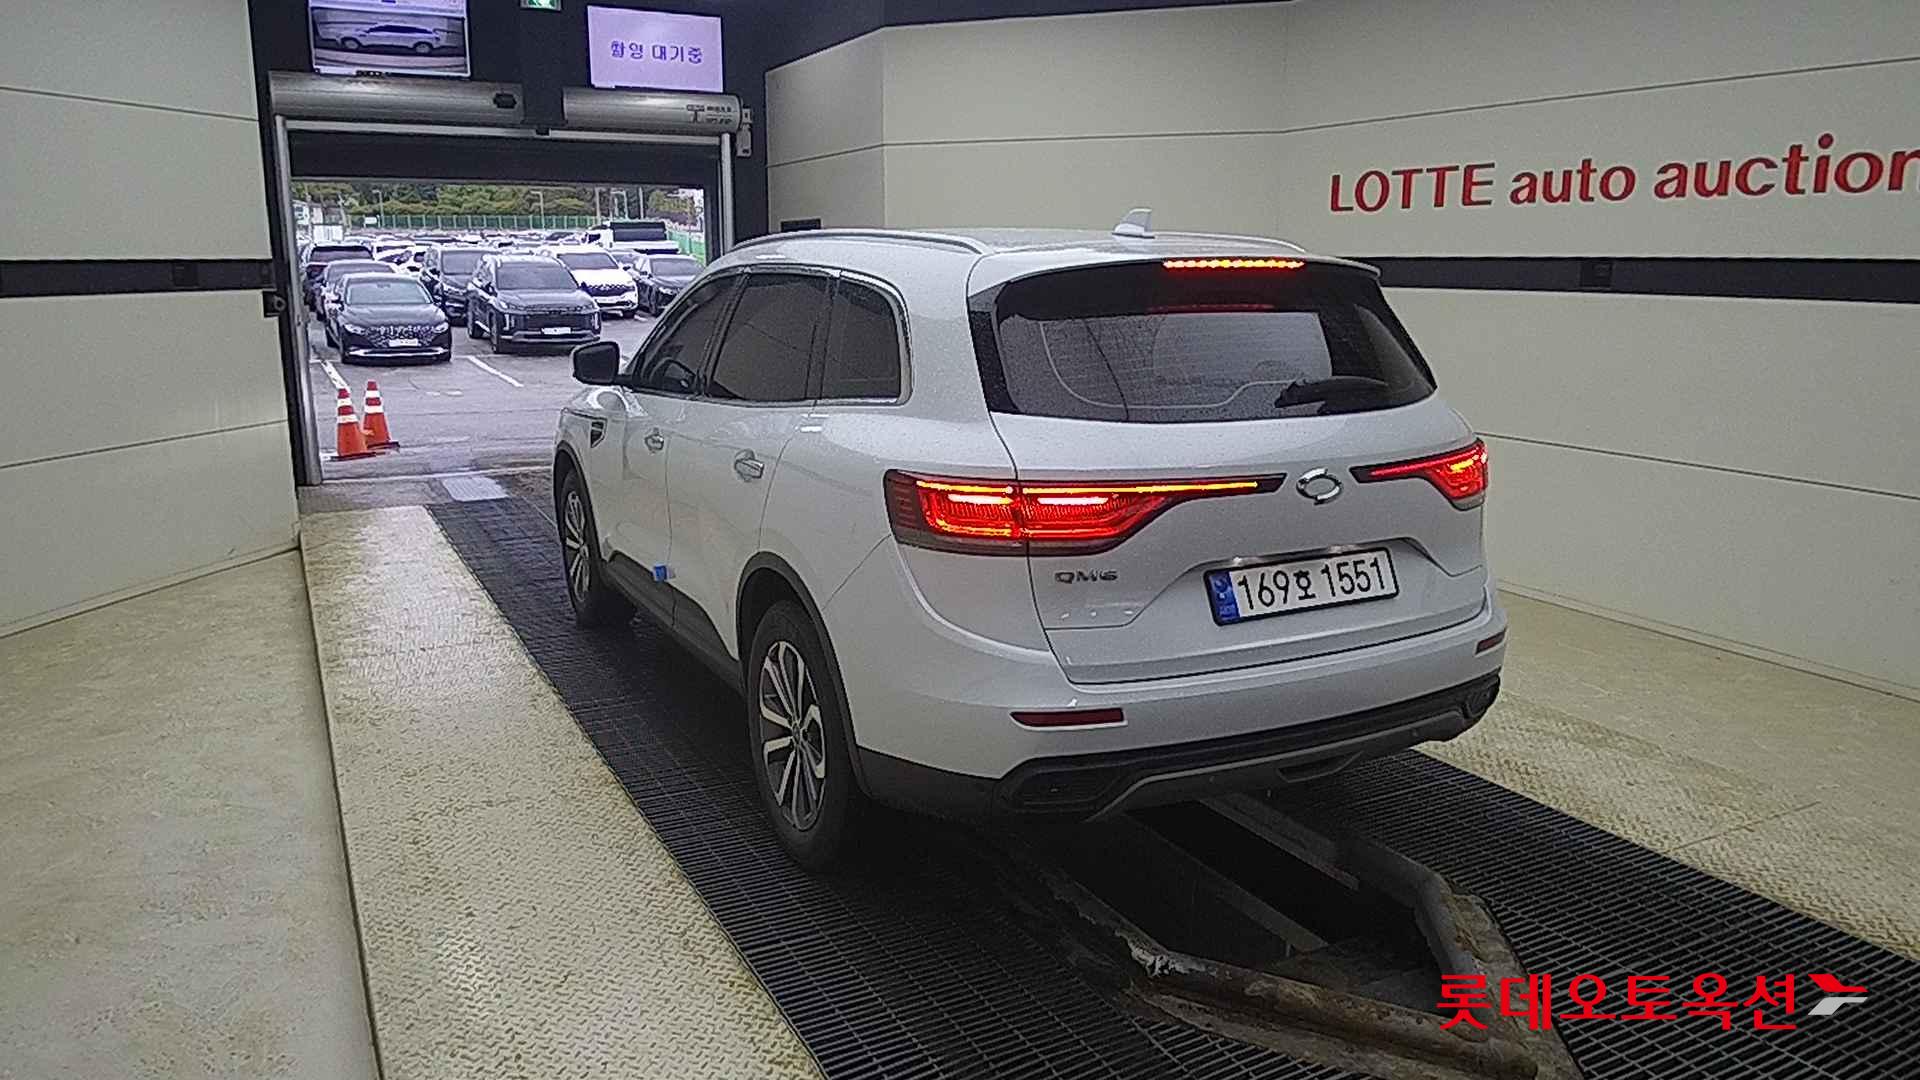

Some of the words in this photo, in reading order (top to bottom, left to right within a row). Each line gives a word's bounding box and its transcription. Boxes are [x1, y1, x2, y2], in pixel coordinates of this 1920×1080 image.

[1331, 163, 1496, 211] LOTTE
[1510, 158, 1637, 205] auto
[1238, 569, 1316, 610] 169호
[1320, 557, 1385, 597] 1551
